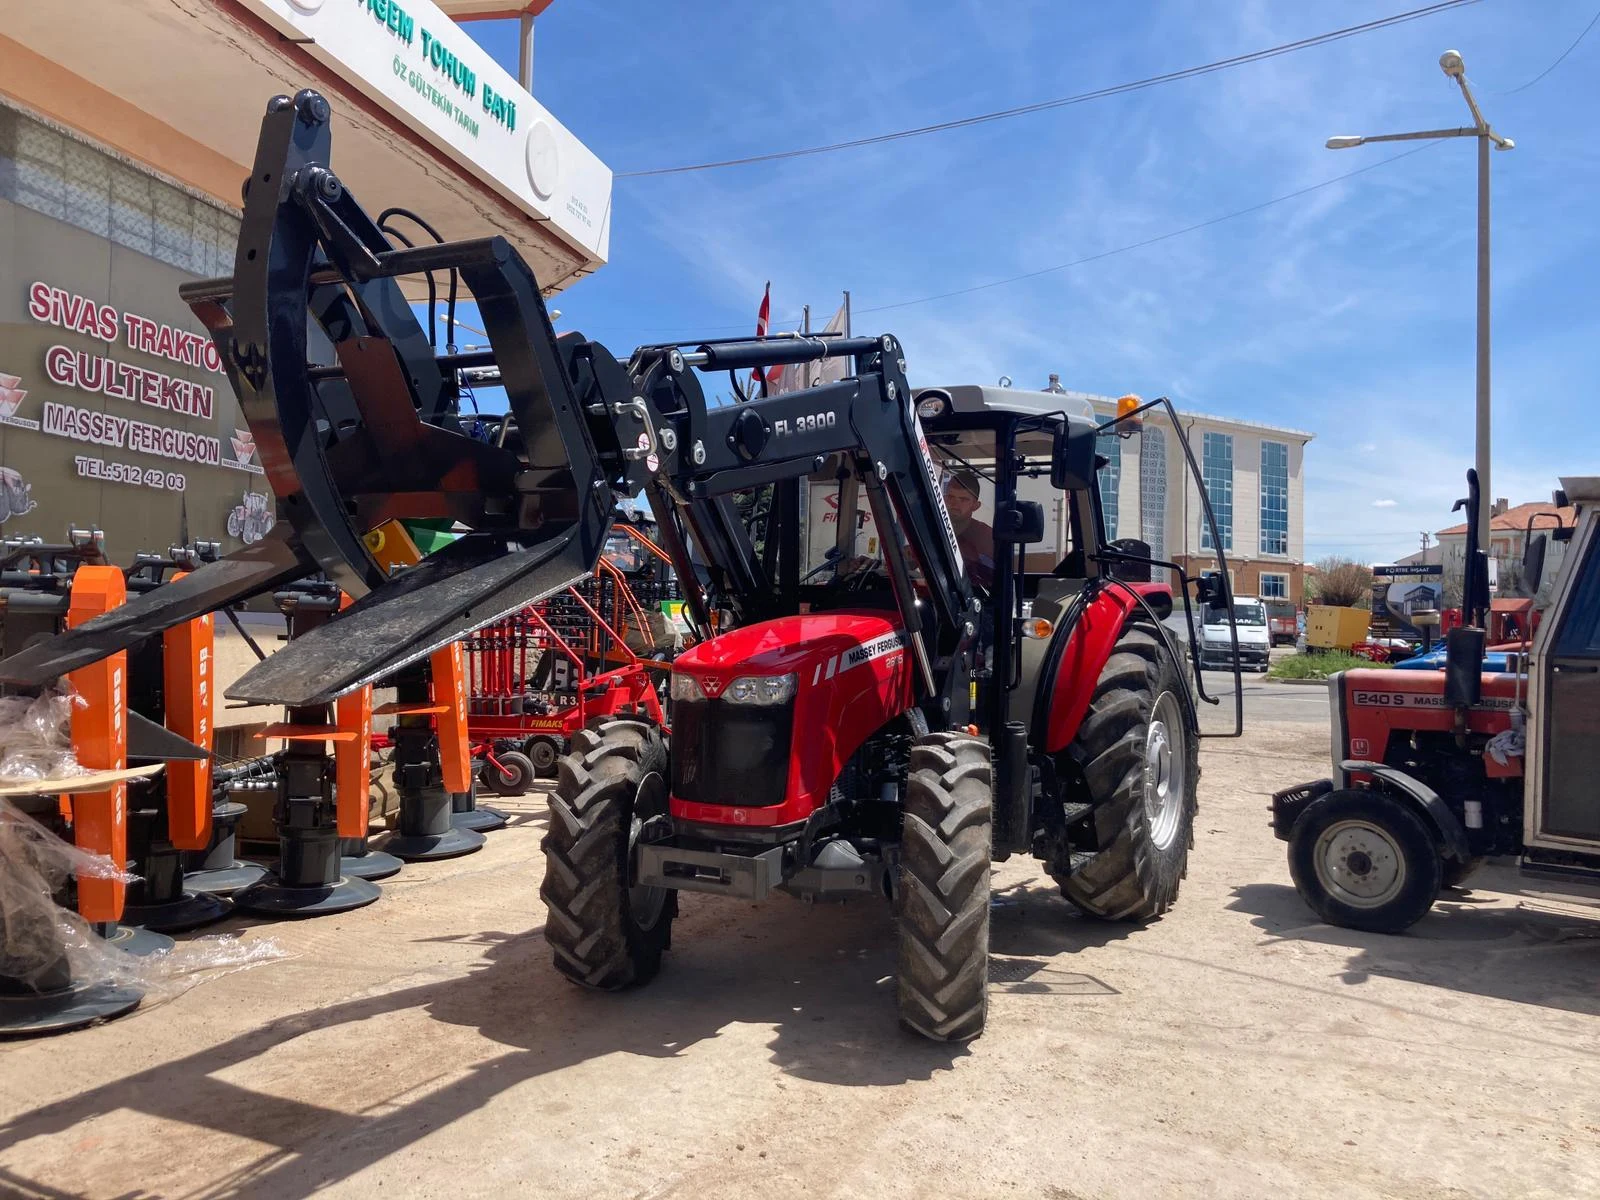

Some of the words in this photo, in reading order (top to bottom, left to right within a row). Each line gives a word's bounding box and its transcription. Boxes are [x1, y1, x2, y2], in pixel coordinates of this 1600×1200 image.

[420, 27, 477, 97] TOHUM
[393, 54, 407, 81] ÖZ
[454, 106, 479, 139] TARIM
[124, 313, 226, 374] TRAKTO
[45, 402, 127, 446] MASSEY
[129, 422, 219, 464] FERGUSON
[775, 420, 792, 436] FL
[796, 411, 836, 432] 3300
[144, 469, 164, 488] 42
[167, 473, 185, 491] 03
[849, 644, 876, 665] MASSEY
[560, 695, 567, 705] R
[1357, 693, 1389, 705] 240
[1393, 694, 1404, 705] S
[1414, 697, 1446, 706] MASS
